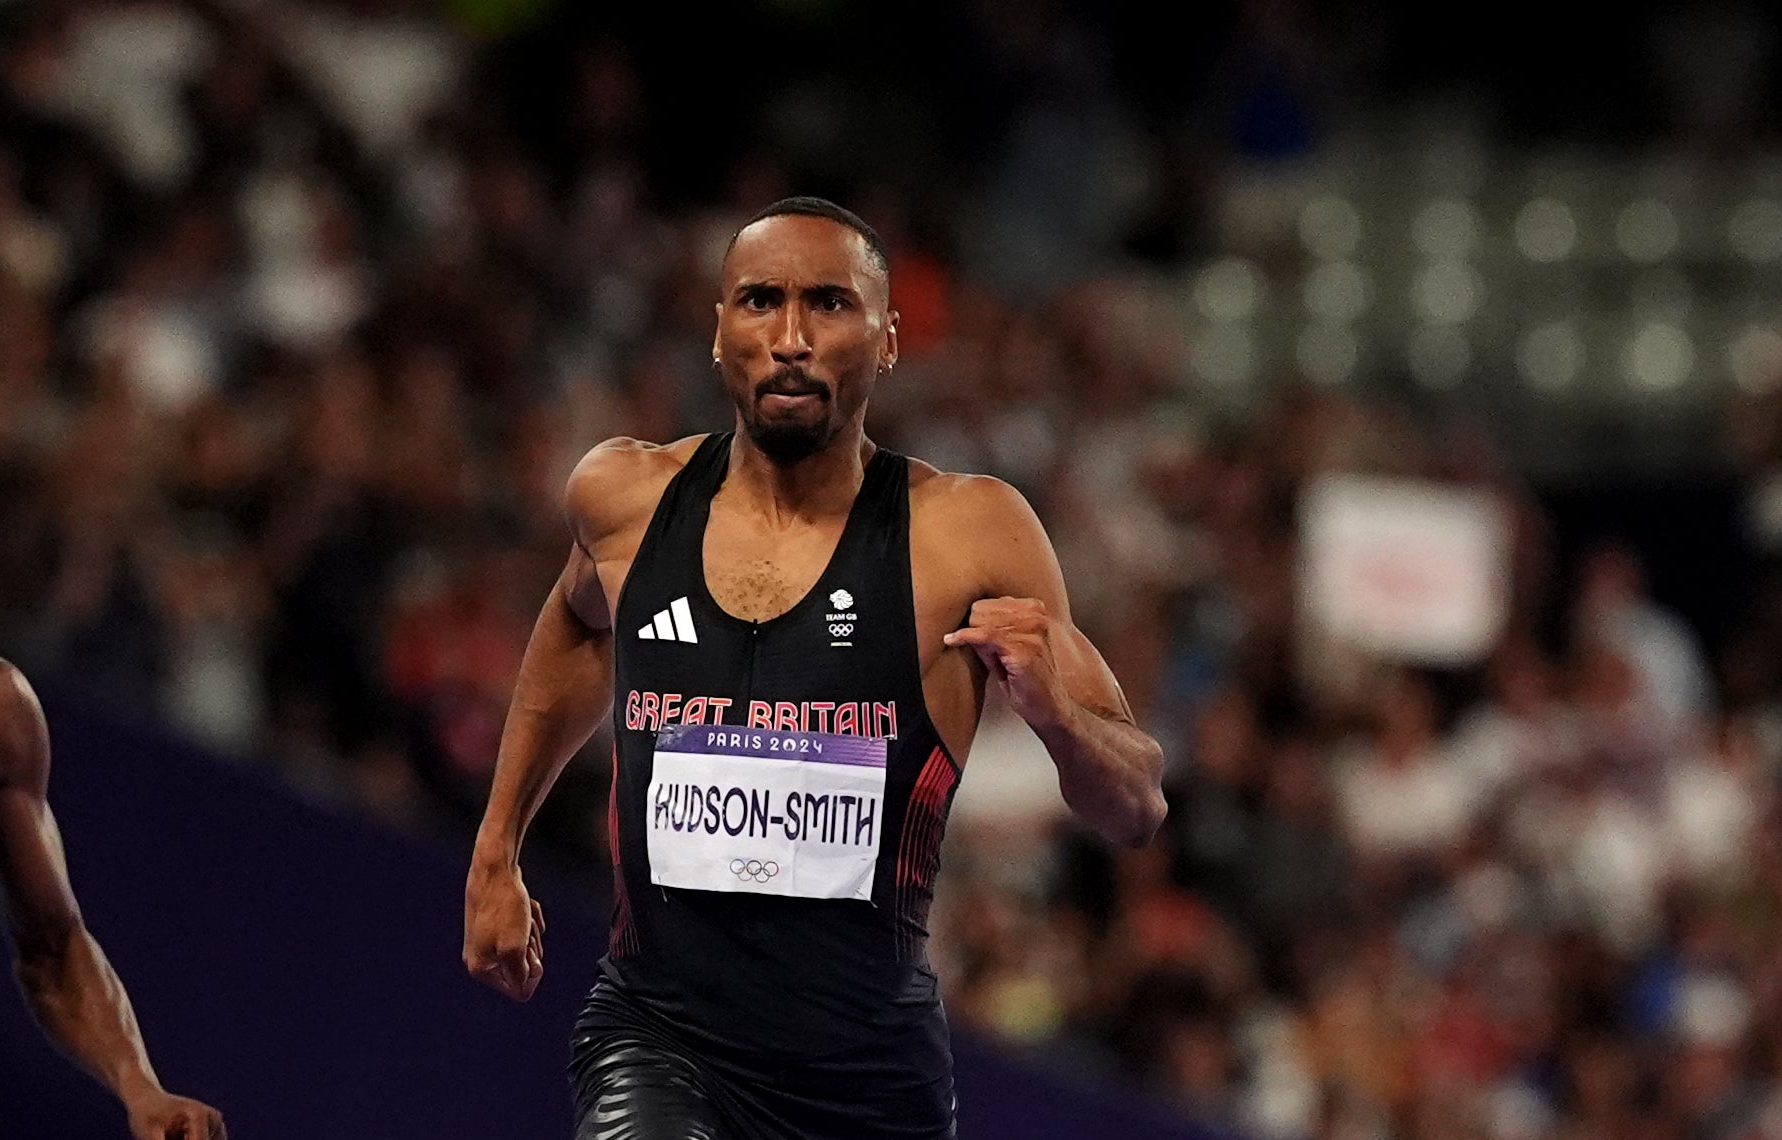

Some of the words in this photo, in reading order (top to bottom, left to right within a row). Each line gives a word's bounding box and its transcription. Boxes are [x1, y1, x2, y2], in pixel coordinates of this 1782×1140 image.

[626, 690, 732, 731] GREAT
[747, 700, 898, 740] BRITAIN
[707, 732, 762, 750] PARIS
[769, 737, 823, 753] 2024
[654, 783, 876, 847] HUDSON-SMITH
